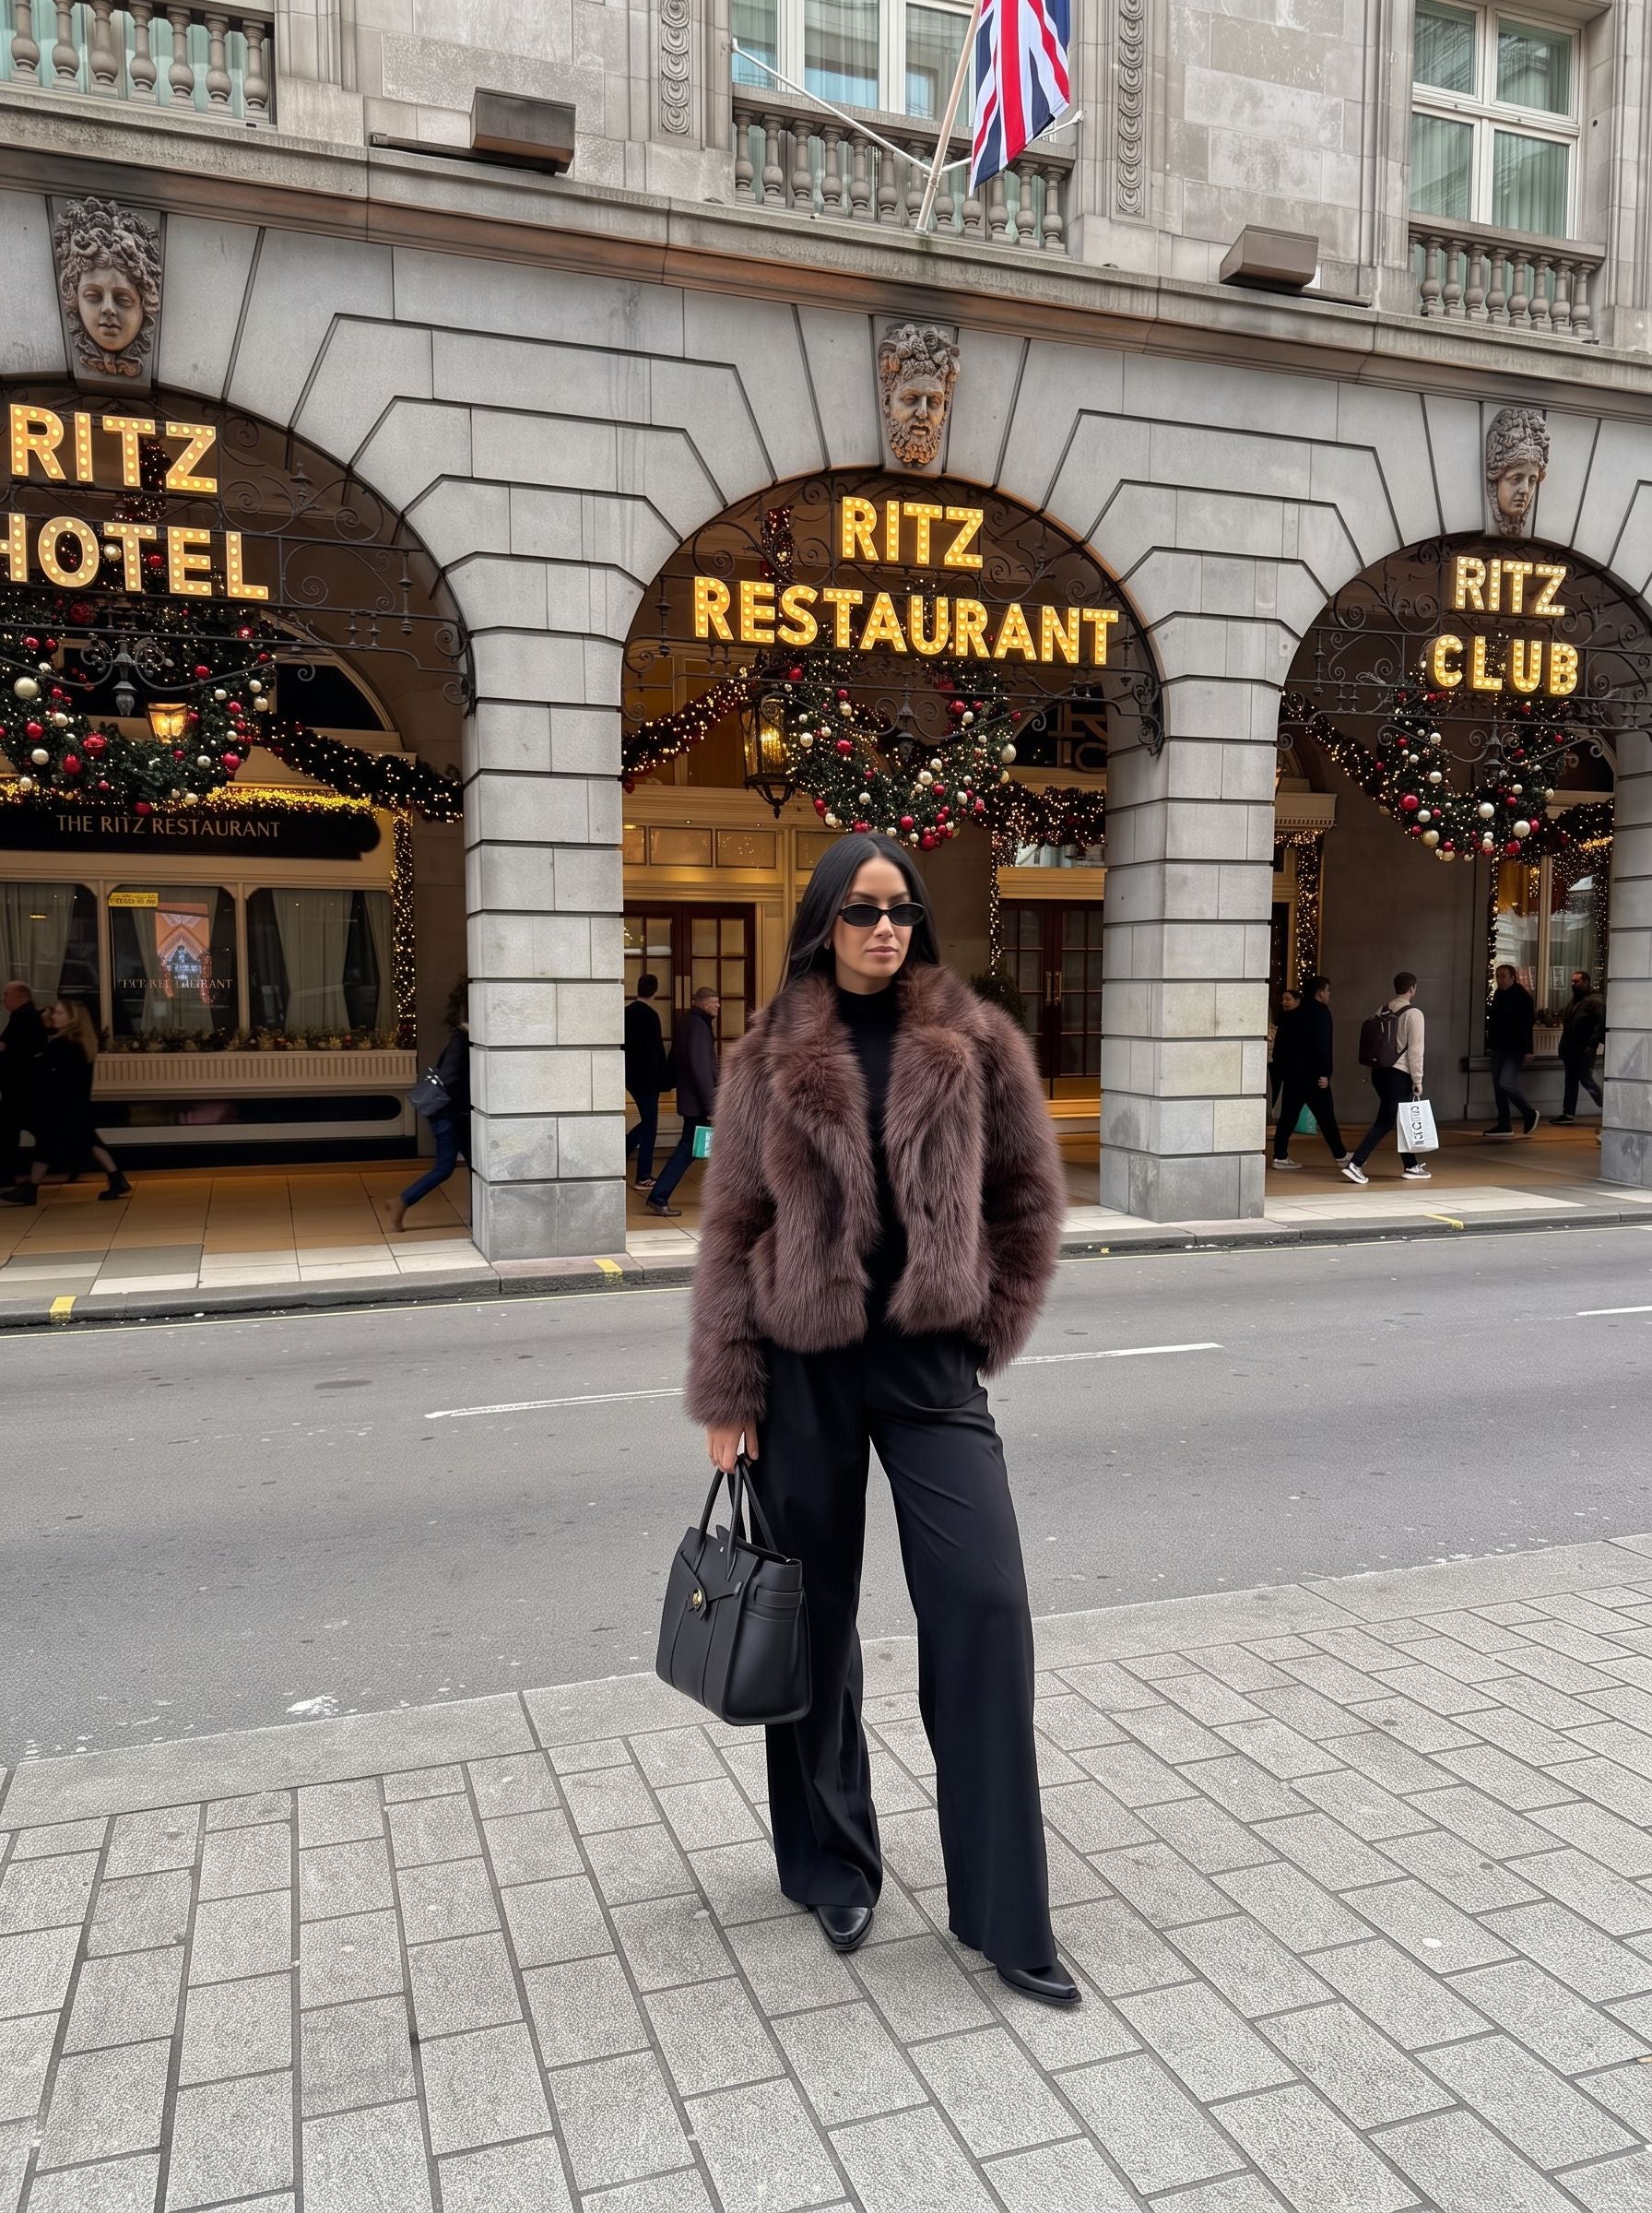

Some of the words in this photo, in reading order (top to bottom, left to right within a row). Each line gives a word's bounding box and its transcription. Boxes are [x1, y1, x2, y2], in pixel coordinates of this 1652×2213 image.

[9, 403, 218, 493] RITZ
[841, 496, 985, 569] RITZ
[1455, 556, 1566, 616] RITZ
[693, 576, 1119, 665] RESTAURANT
[1433, 634, 1579, 696] CLUB
[56, 814, 93, 833] THE
[100, 816, 145, 834] RITZ
[152, 818, 280, 838] RESTAURANT
